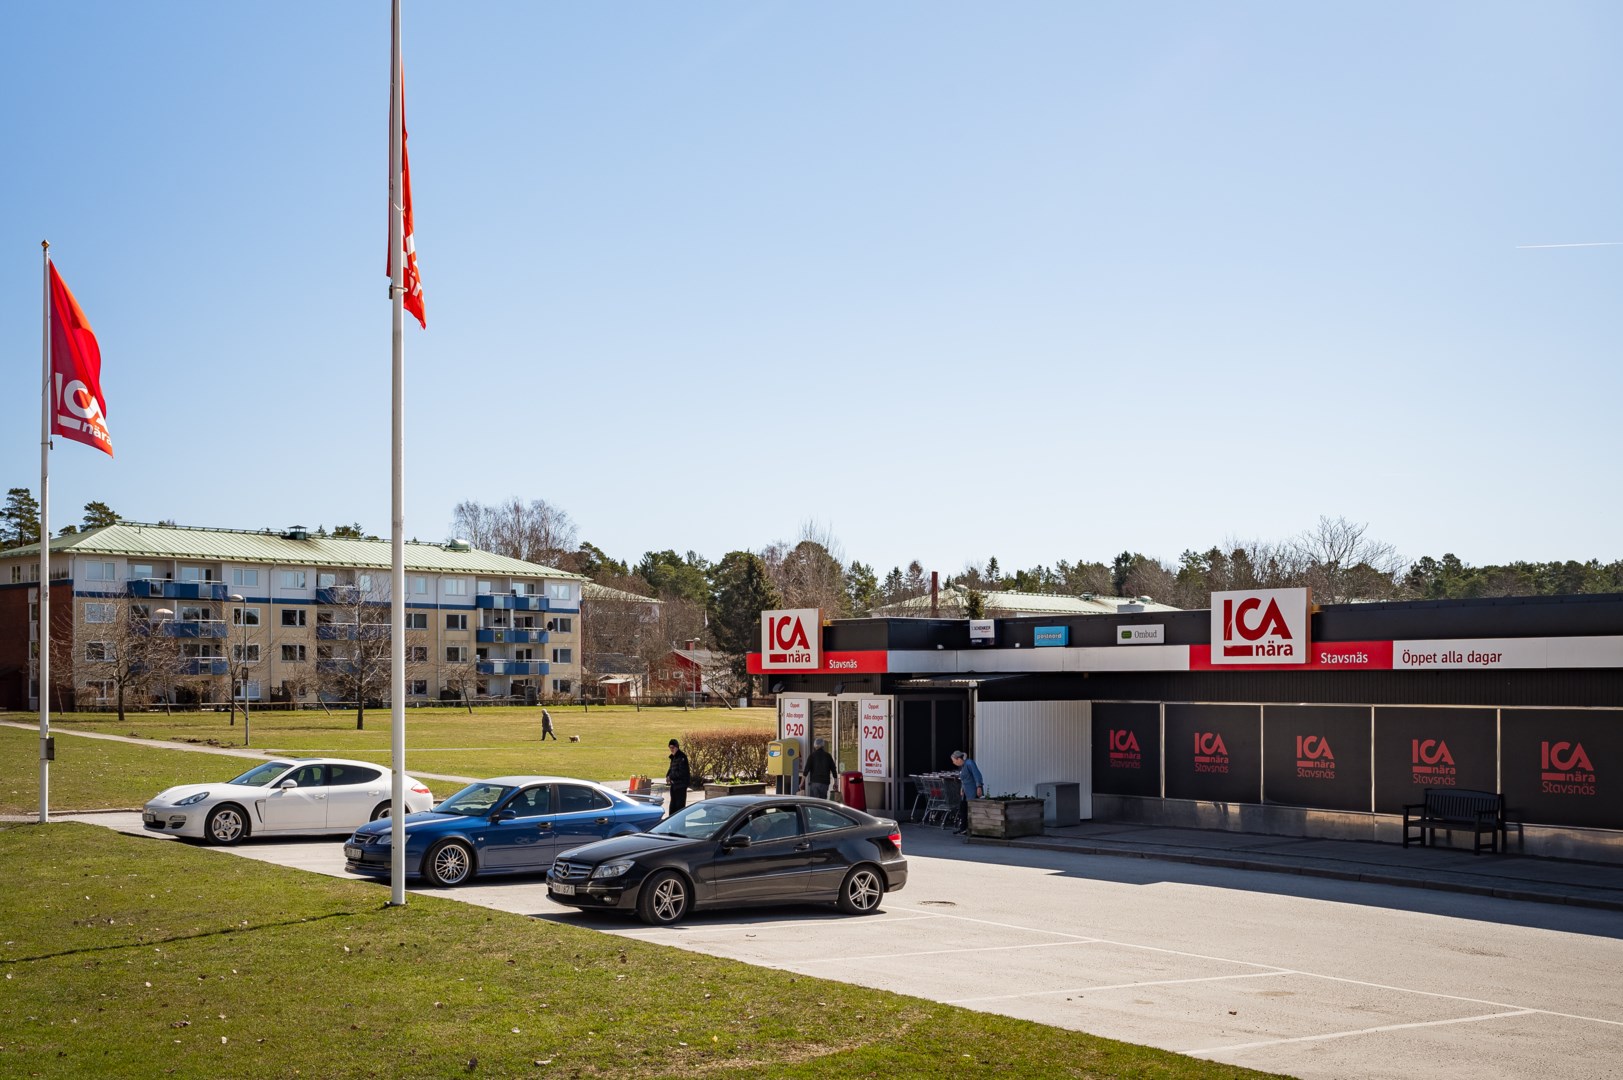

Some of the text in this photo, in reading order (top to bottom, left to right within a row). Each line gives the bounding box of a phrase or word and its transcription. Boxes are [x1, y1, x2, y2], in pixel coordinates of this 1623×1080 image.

[1223, 597, 1292, 641] ICA
[768, 616, 810, 650] ICA
[1036, 631, 1062, 640] postnord
[1134, 630, 1158, 639] Ombud
[1255, 641, 1294, 657] nära
[788, 650, 811, 663] nära
[1320, 651, 1368, 664] Stavsnäs
[1402, 649, 1502, 666] Öppet alla dagar
[829, 659, 858, 669] Stavsnäs
[786, 723, 804, 736] 9-20
[864, 726, 884, 740] 9-20
[1110, 730, 1140, 752] ICA
[1194, 732, 1228, 755] ICA
[1296, 735, 1334, 759] ICA
[865, 749, 881, 763] ICA
[1124, 751, 1141, 759] nära
[1412, 739, 1455, 765] ICA
[1541, 741, 1594, 770] ICA
[1110, 759, 1141, 769] Stavsnäs
[1210, 755, 1229, 764] nära
[1314, 759, 1335, 768] nära
[1194, 762, 1229, 774] Stavsnäs
[1297, 767, 1335, 780] Stavsnäs
[1432, 765, 1455, 774] nära
[1412, 773, 1456, 786] Stavsnäs
[1565, 771, 1595, 782] nära
[1542, 782, 1595, 795] Stavsnäs
